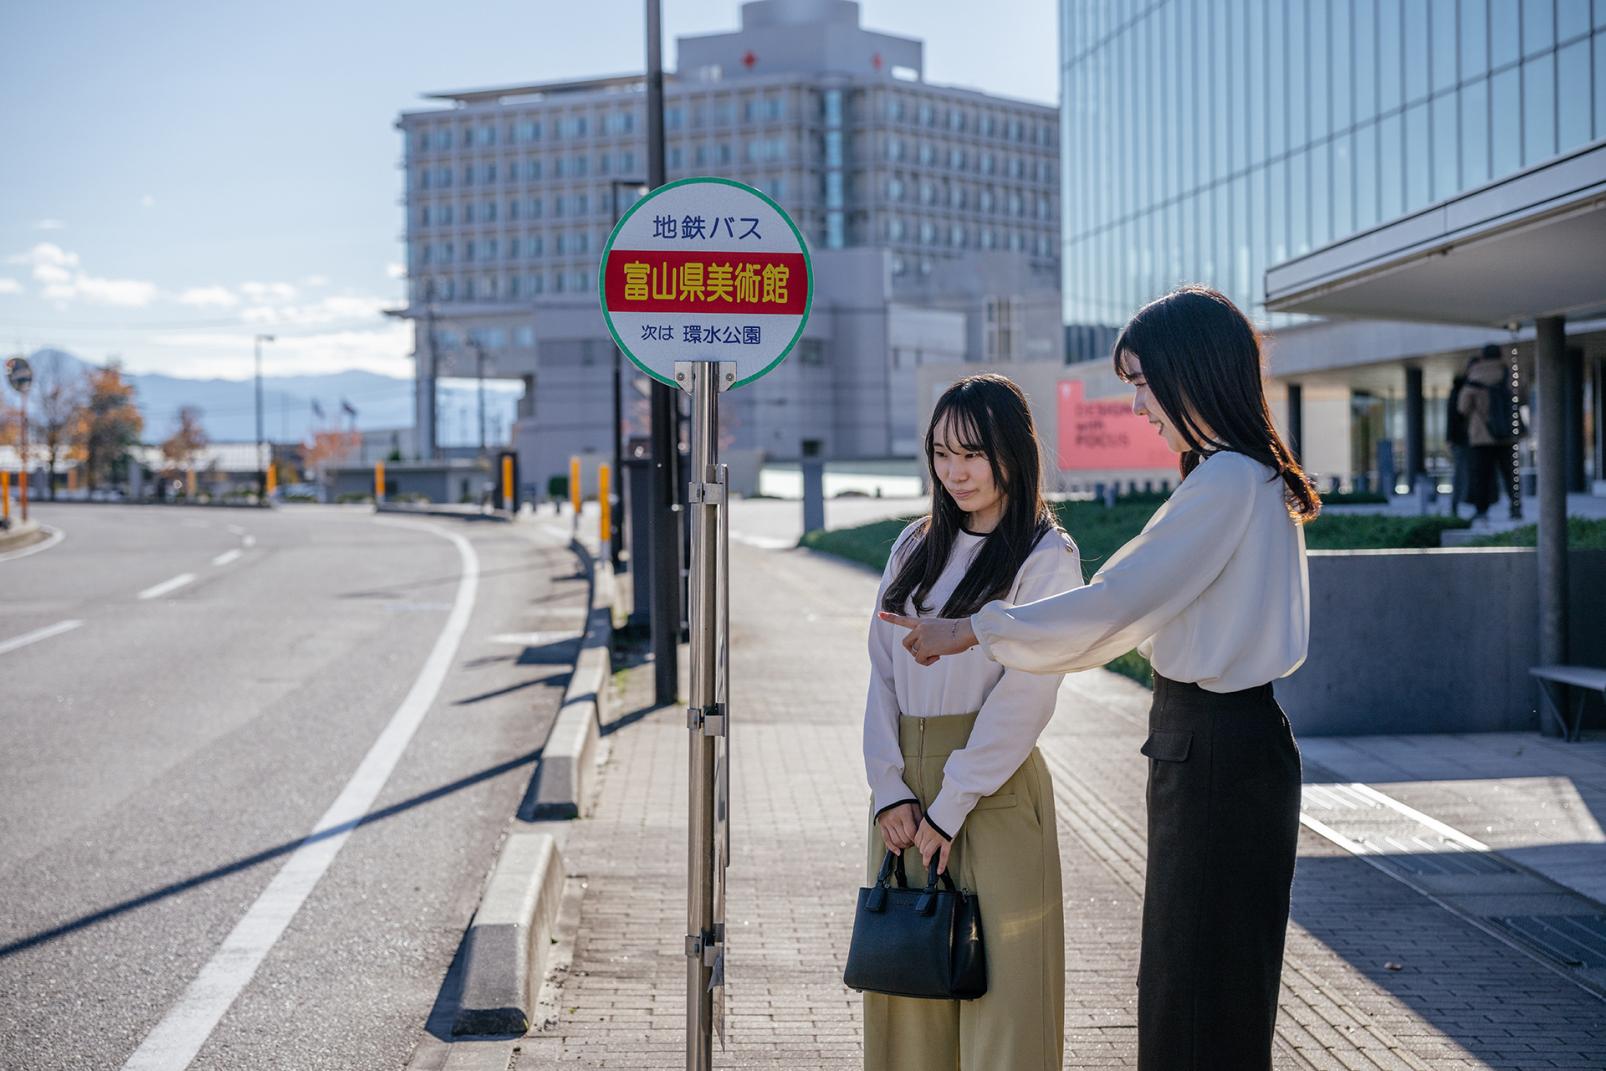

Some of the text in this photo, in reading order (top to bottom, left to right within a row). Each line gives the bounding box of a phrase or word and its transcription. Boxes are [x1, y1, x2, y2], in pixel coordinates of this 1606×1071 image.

[652, 215, 762, 240] 地鉄バス
[623, 260, 790, 304] 富山県美術館
[640, 325, 761, 345] 次は 環水公園
